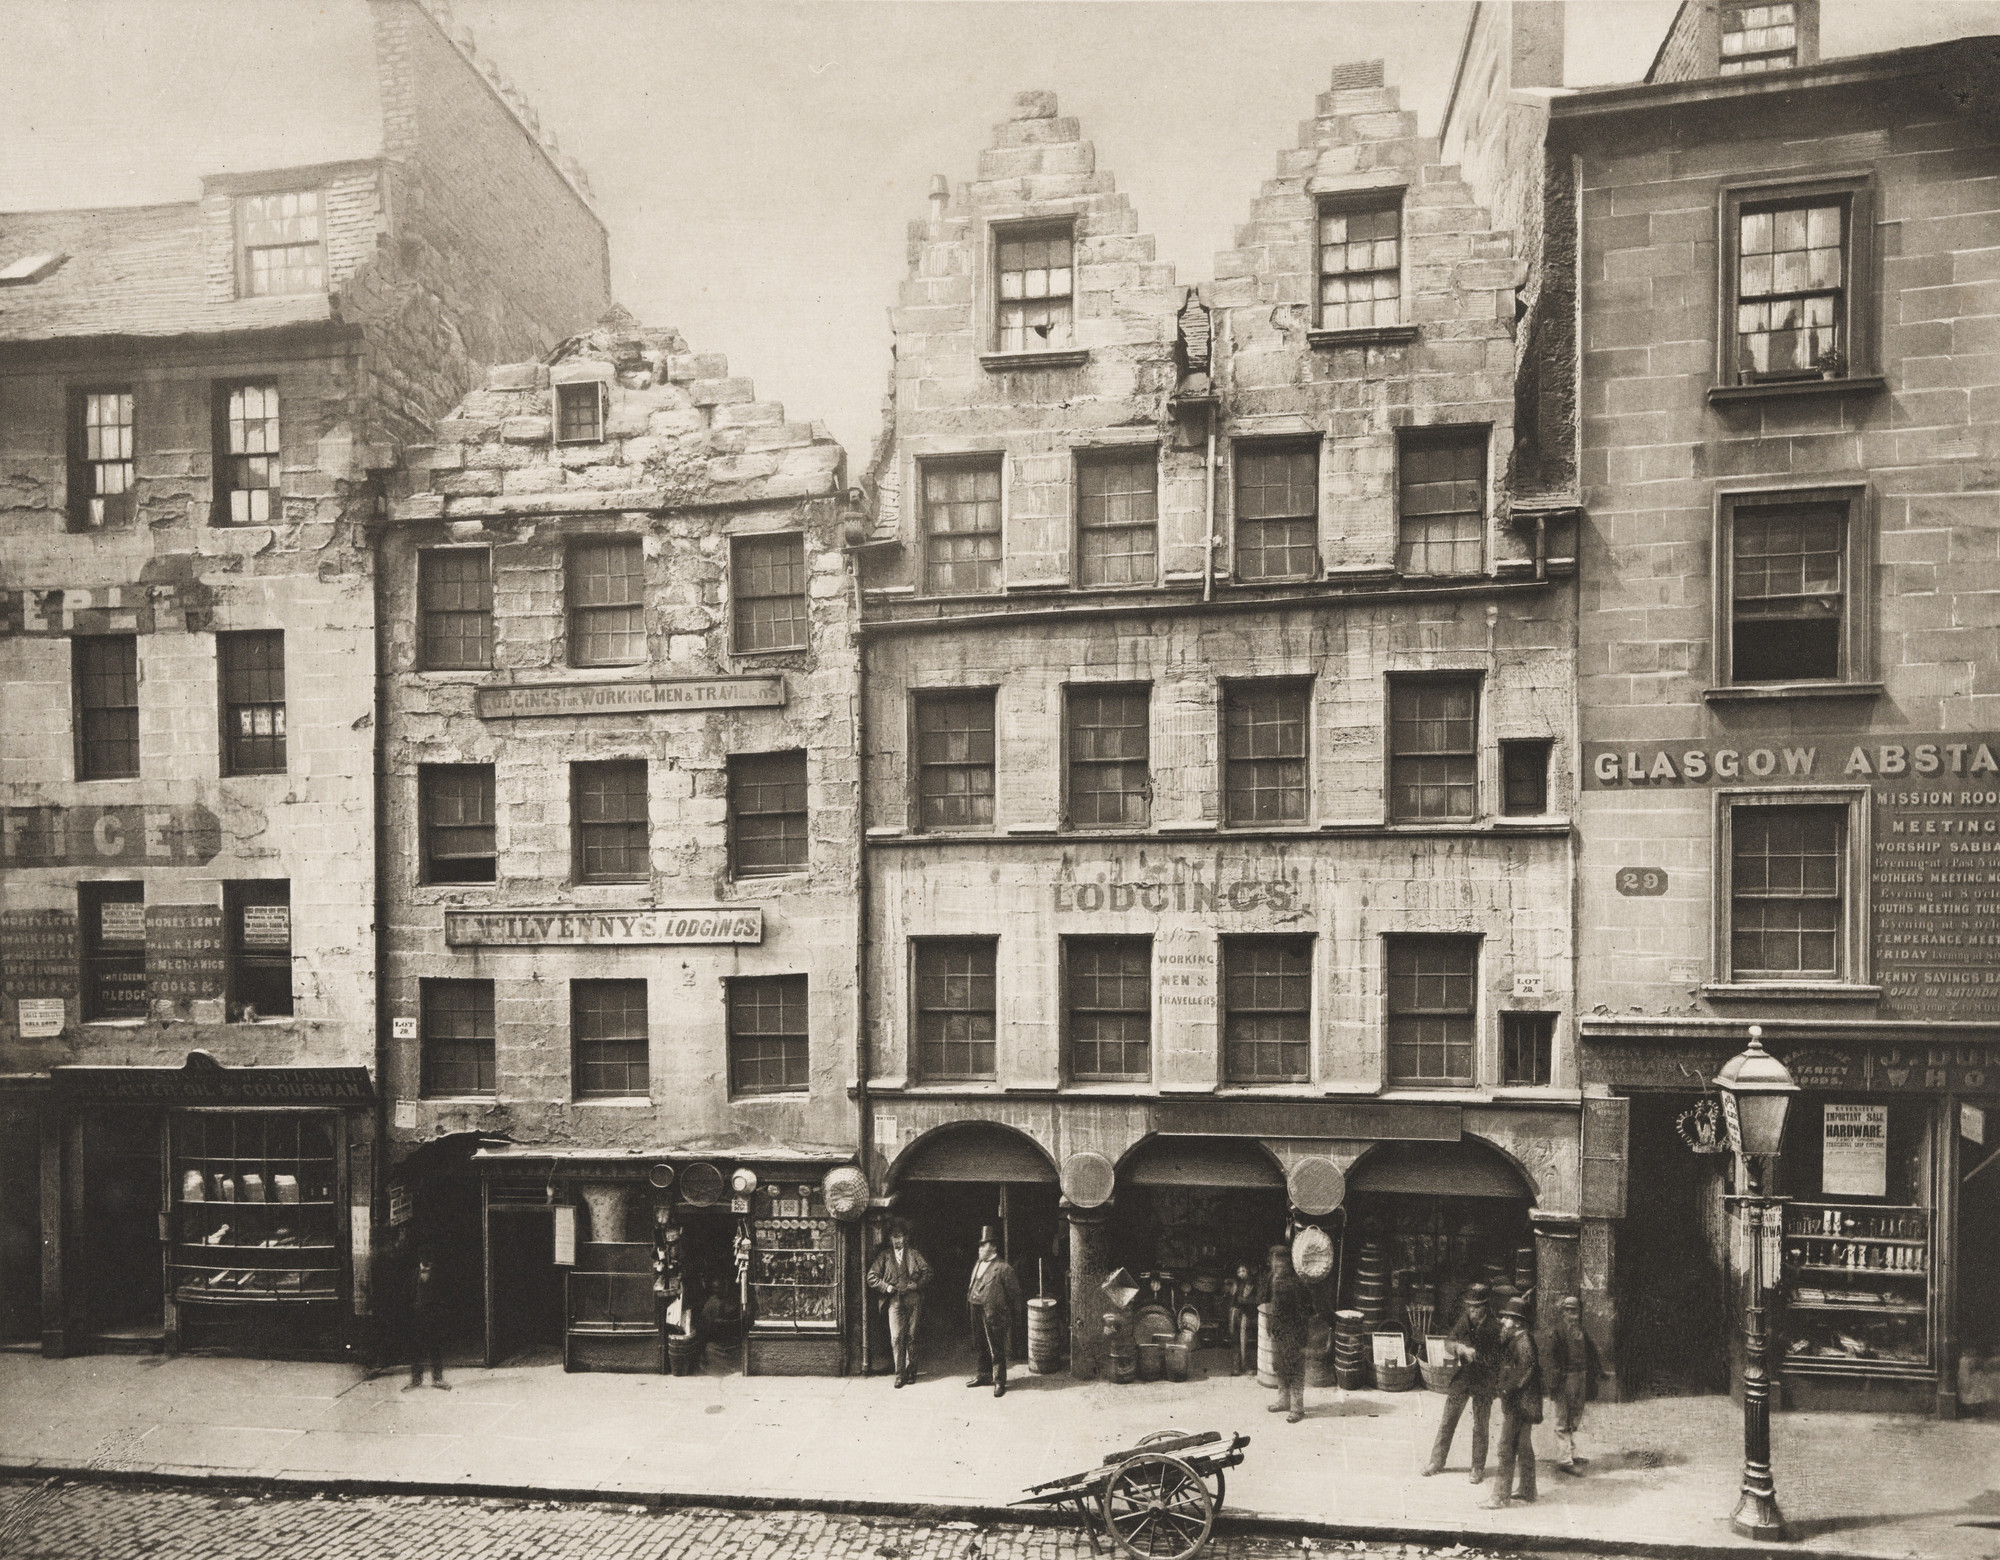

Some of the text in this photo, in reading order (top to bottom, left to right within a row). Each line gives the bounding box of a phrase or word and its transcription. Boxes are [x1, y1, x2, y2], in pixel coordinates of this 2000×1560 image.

[580, 689, 651, 706] WORKING
[654, 688, 683, 702] MEN
[685, 693, 693, 702] &
[1594, 743, 2000, 781] GLASGOW ABSTA
[1877, 792, 2000, 805] MISSION ROO
[1893, 820, 1996, 833] MEETING
[1875, 842, 1941, 852] WORSHIP
[1622, 873, 1660, 890] 29
[145, 917, 221, 928] MONEY LENT
[665, 917, 760, 939] LODGINGS.
[175, 939, 221, 949] KINDS
[1876, 934, 1962, 944] TEMPERANCE
[1158, 954, 1215, 965] WORKING
[1876, 950, 1927, 959] FRIDAY
[1161, 975, 1208, 986] MEN &
[1876, 971, 1918, 982] PENNY
[1924, 972, 1980, 983] SAVINGS
[1925, 987, 1939, 996] ON
[1158, 995, 1217, 1006] TRAVELLERS
[1826, 1112, 1862, 1122] IMPORTANT
